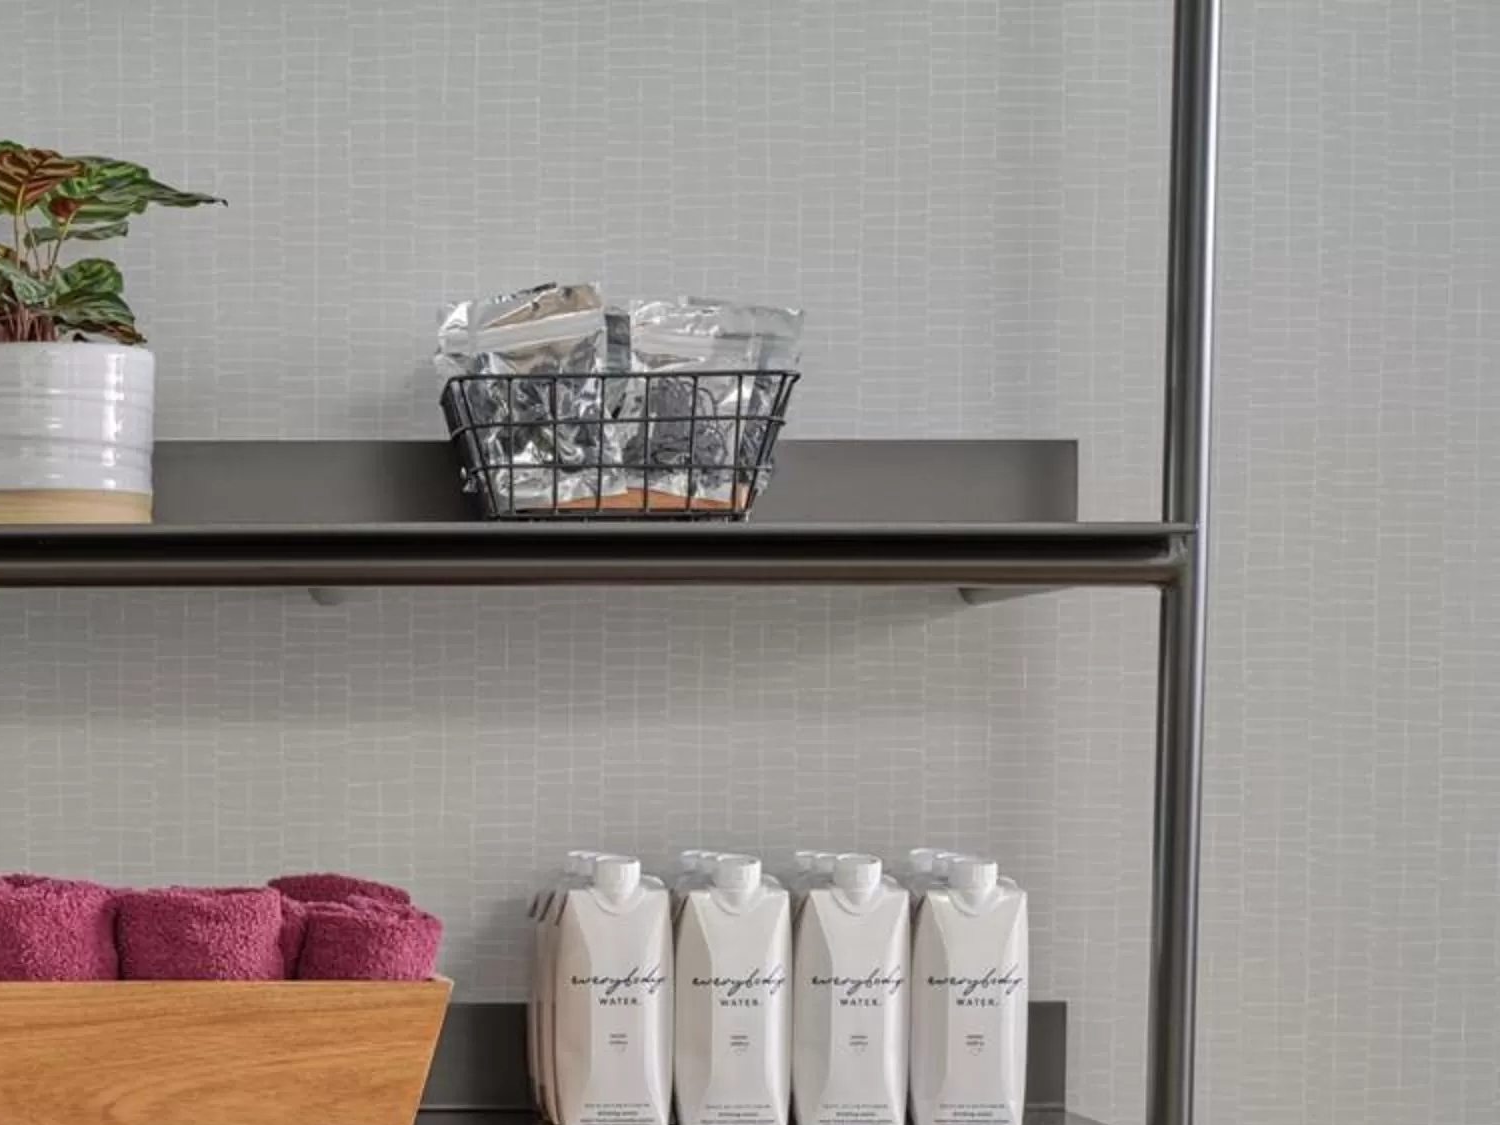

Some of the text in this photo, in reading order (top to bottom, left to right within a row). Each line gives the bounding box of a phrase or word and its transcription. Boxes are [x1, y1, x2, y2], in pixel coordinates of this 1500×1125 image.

[571, 964, 666, 995] everybody
[692, 965, 785, 997] everybody
[811, 965, 903, 995] everybody
[927, 964, 1022, 995] everybody
